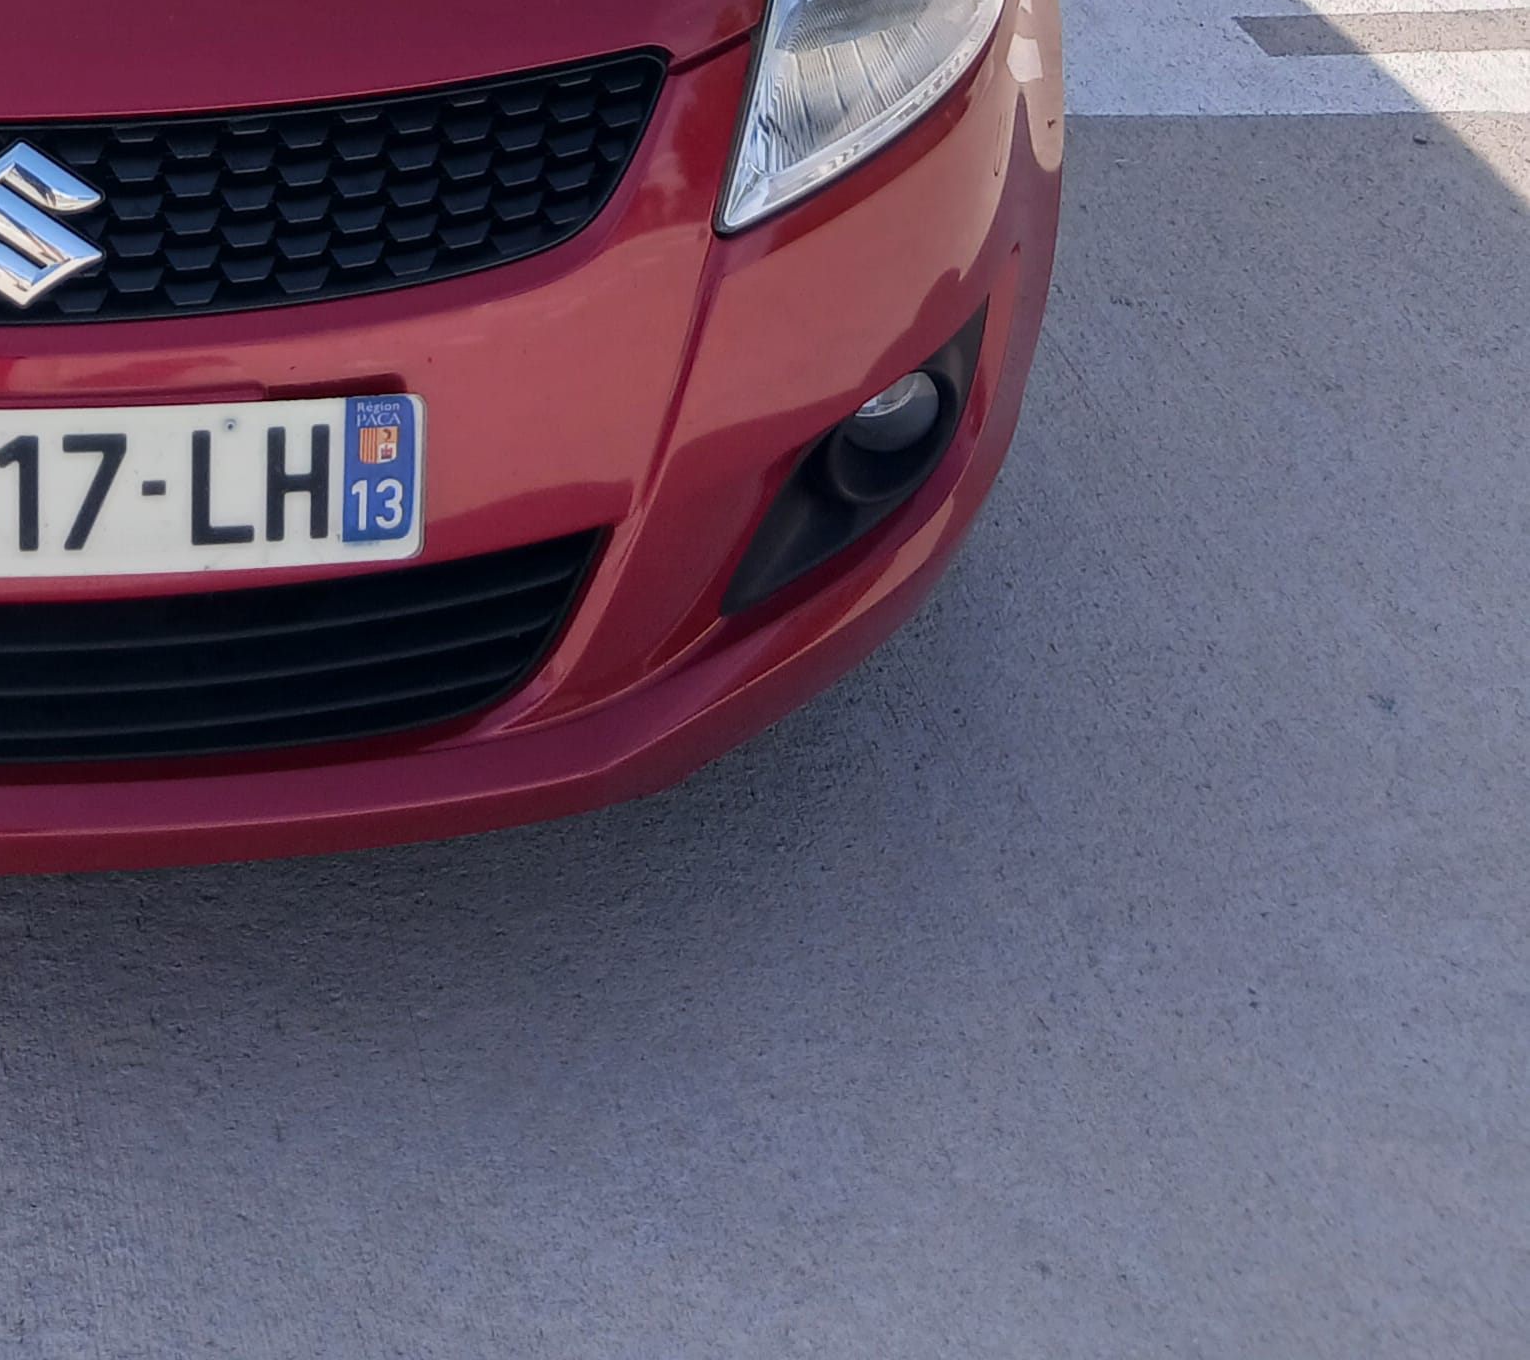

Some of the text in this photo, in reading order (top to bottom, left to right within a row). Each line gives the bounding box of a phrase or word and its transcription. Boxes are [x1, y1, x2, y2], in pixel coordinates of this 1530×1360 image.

[356, 401, 401, 414] Région
[356, 412, 401, 427] PACA
[351, 478, 404, 531] 13
